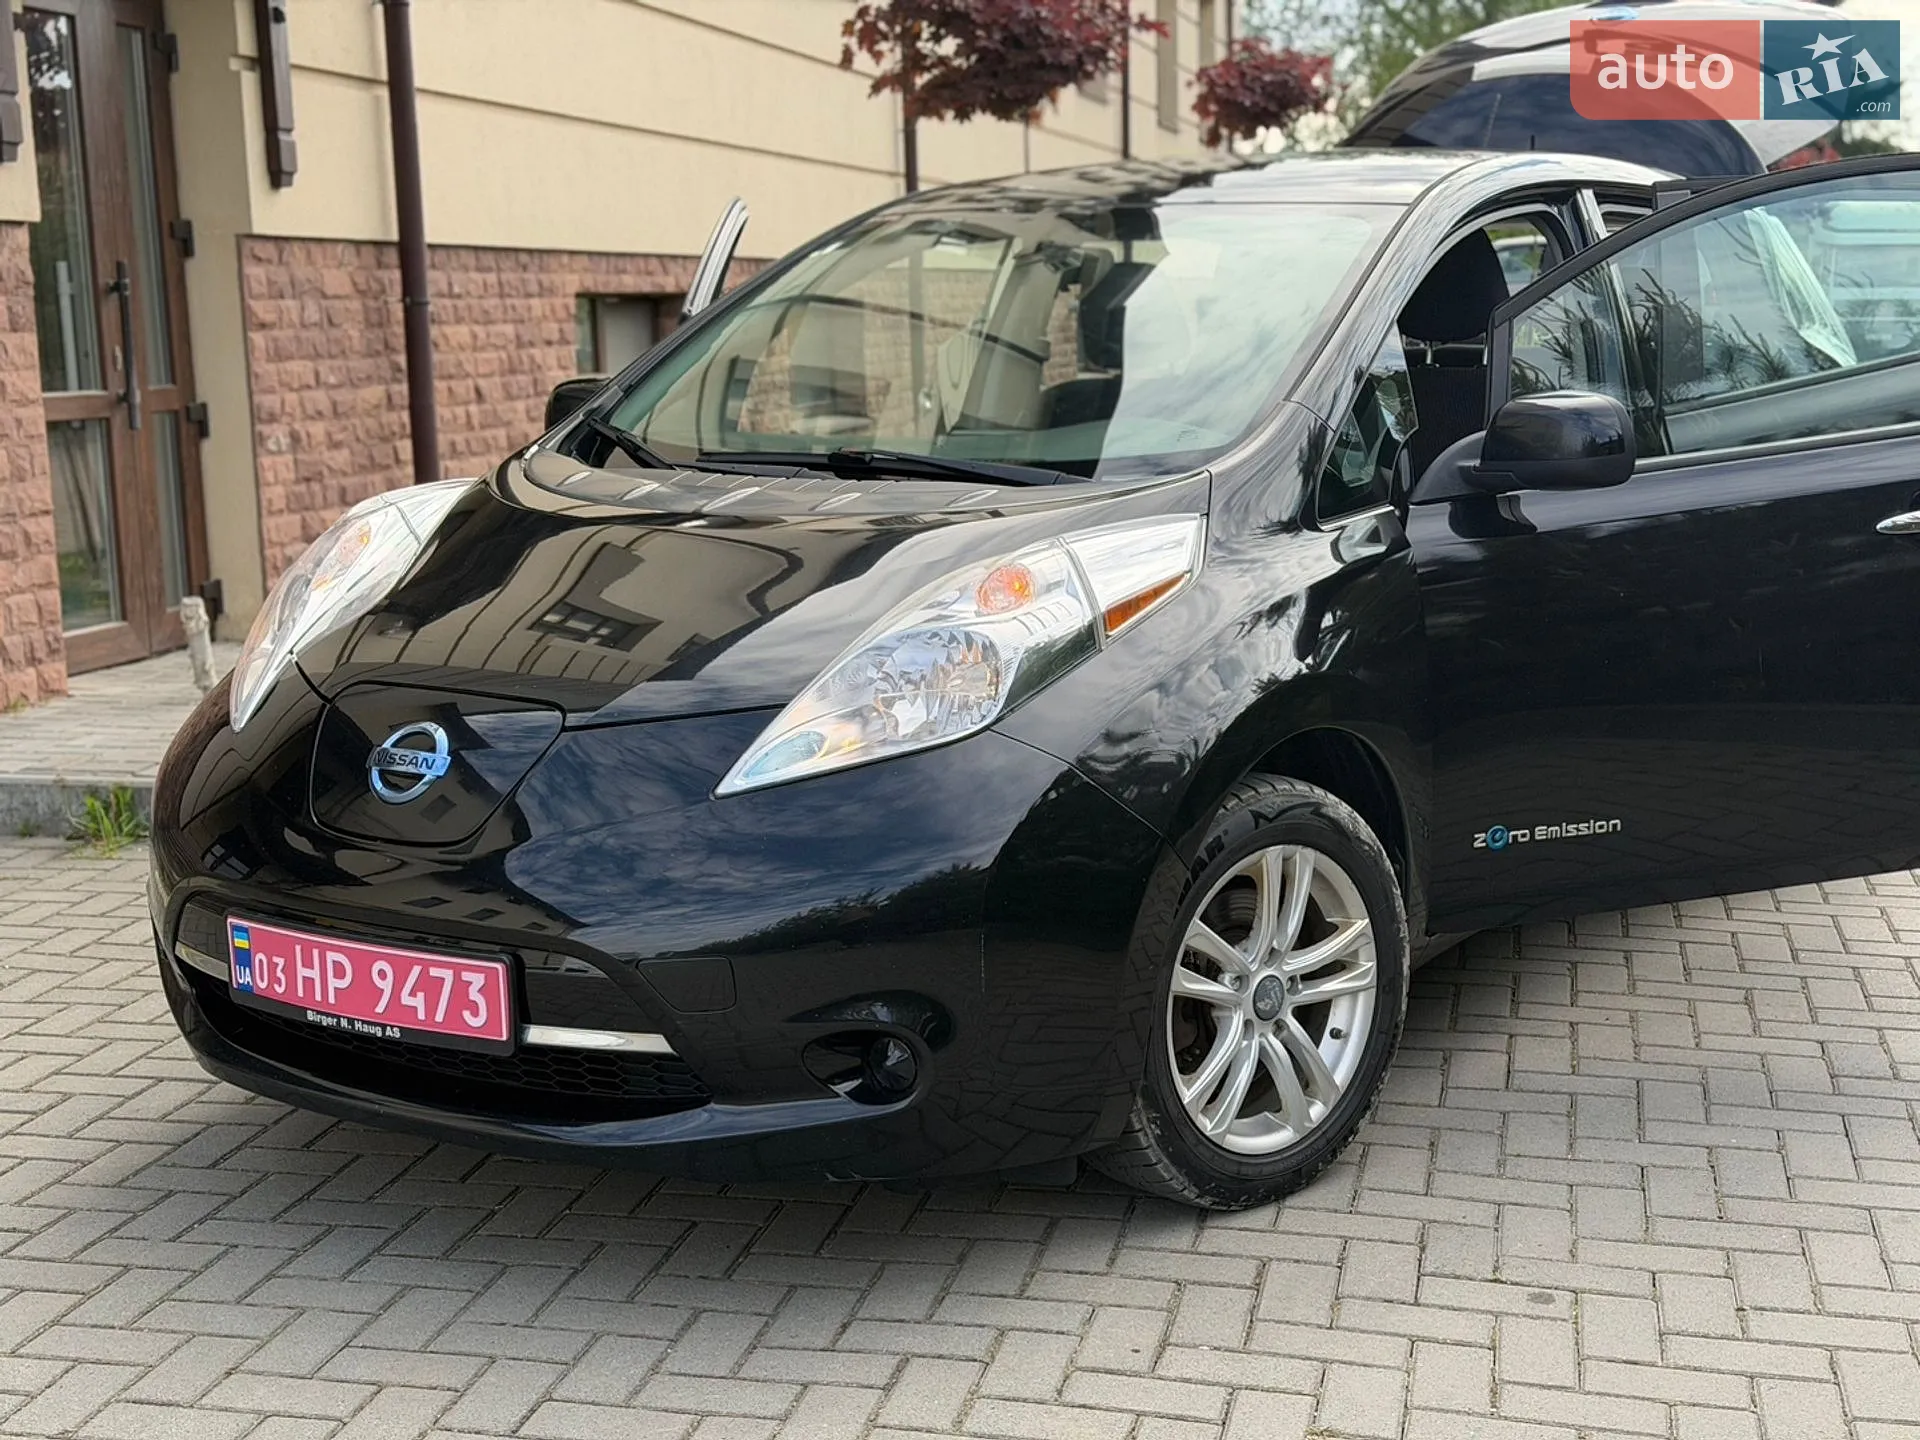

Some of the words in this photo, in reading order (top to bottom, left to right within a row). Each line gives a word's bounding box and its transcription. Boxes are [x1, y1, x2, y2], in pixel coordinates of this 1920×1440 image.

[374, 751, 436, 770] NISSAN
[1535, 819, 1621, 840] Emission
[236, 965, 253, 986] UA
[371, 960, 488, 1028] 9473
[306, 1010, 338, 1026] Birger
[340, 1017, 352, 1029] N.
[354, 1020, 382, 1037] Haug
[385, 1026, 401, 1038] AS
